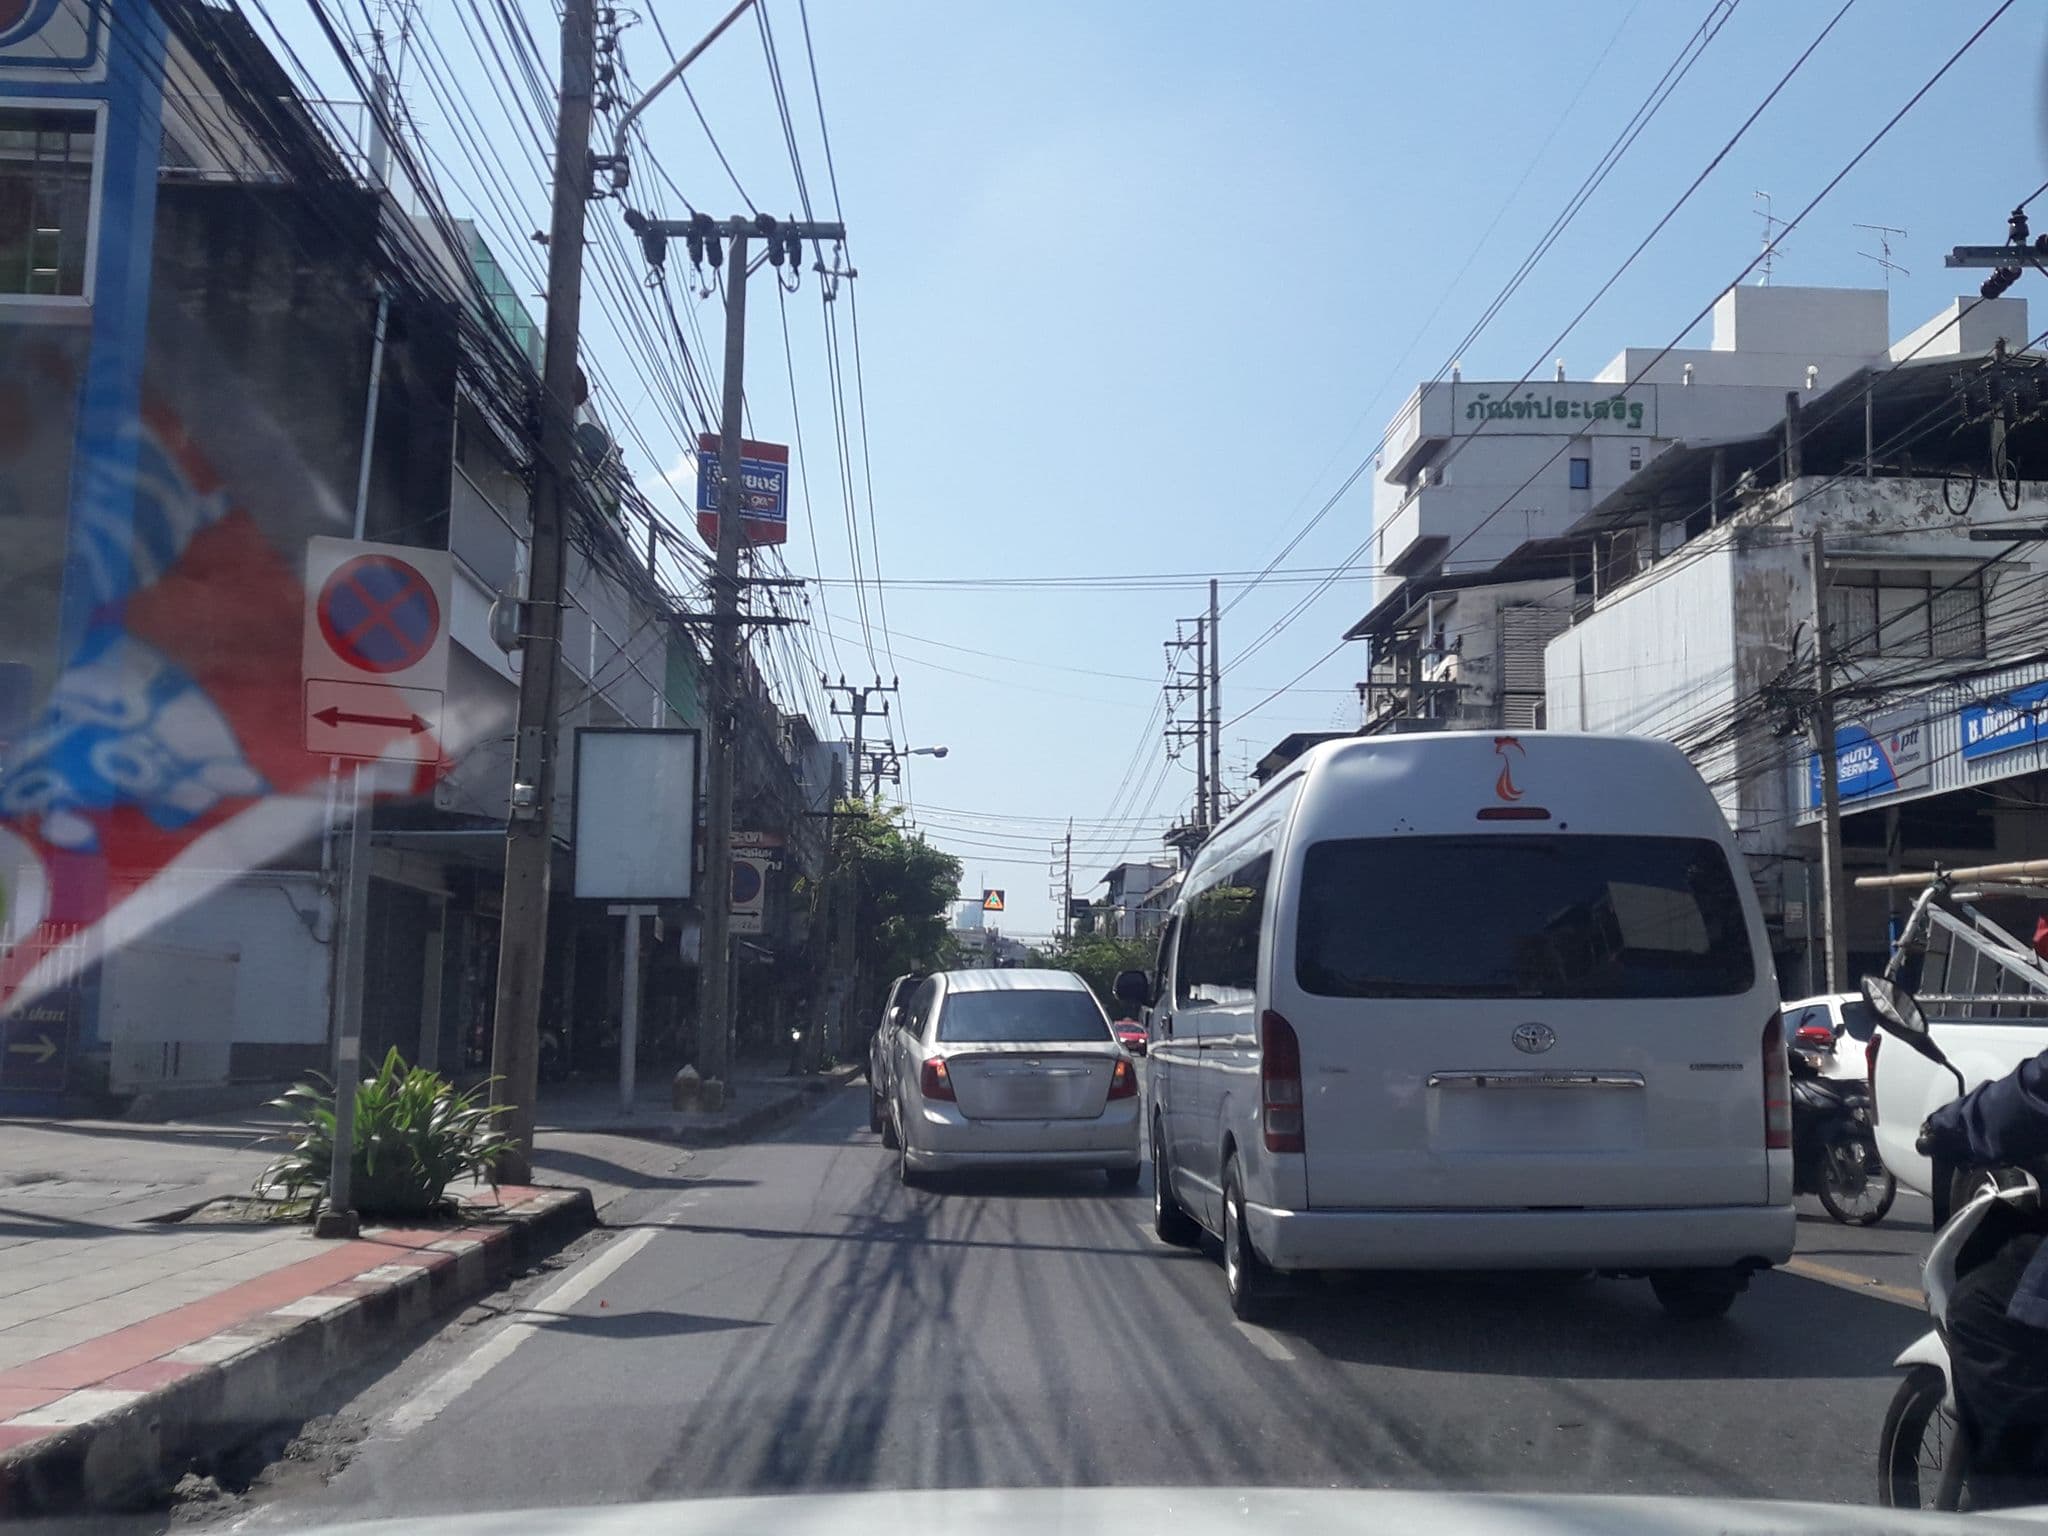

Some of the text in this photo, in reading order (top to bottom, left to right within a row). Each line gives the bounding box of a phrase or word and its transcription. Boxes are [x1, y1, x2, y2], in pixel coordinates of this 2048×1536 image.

[1900, 728, 1919, 752] ptt
[1842, 746, 1873, 765] AUTO
[1840, 757, 1880, 778] SERVICE
